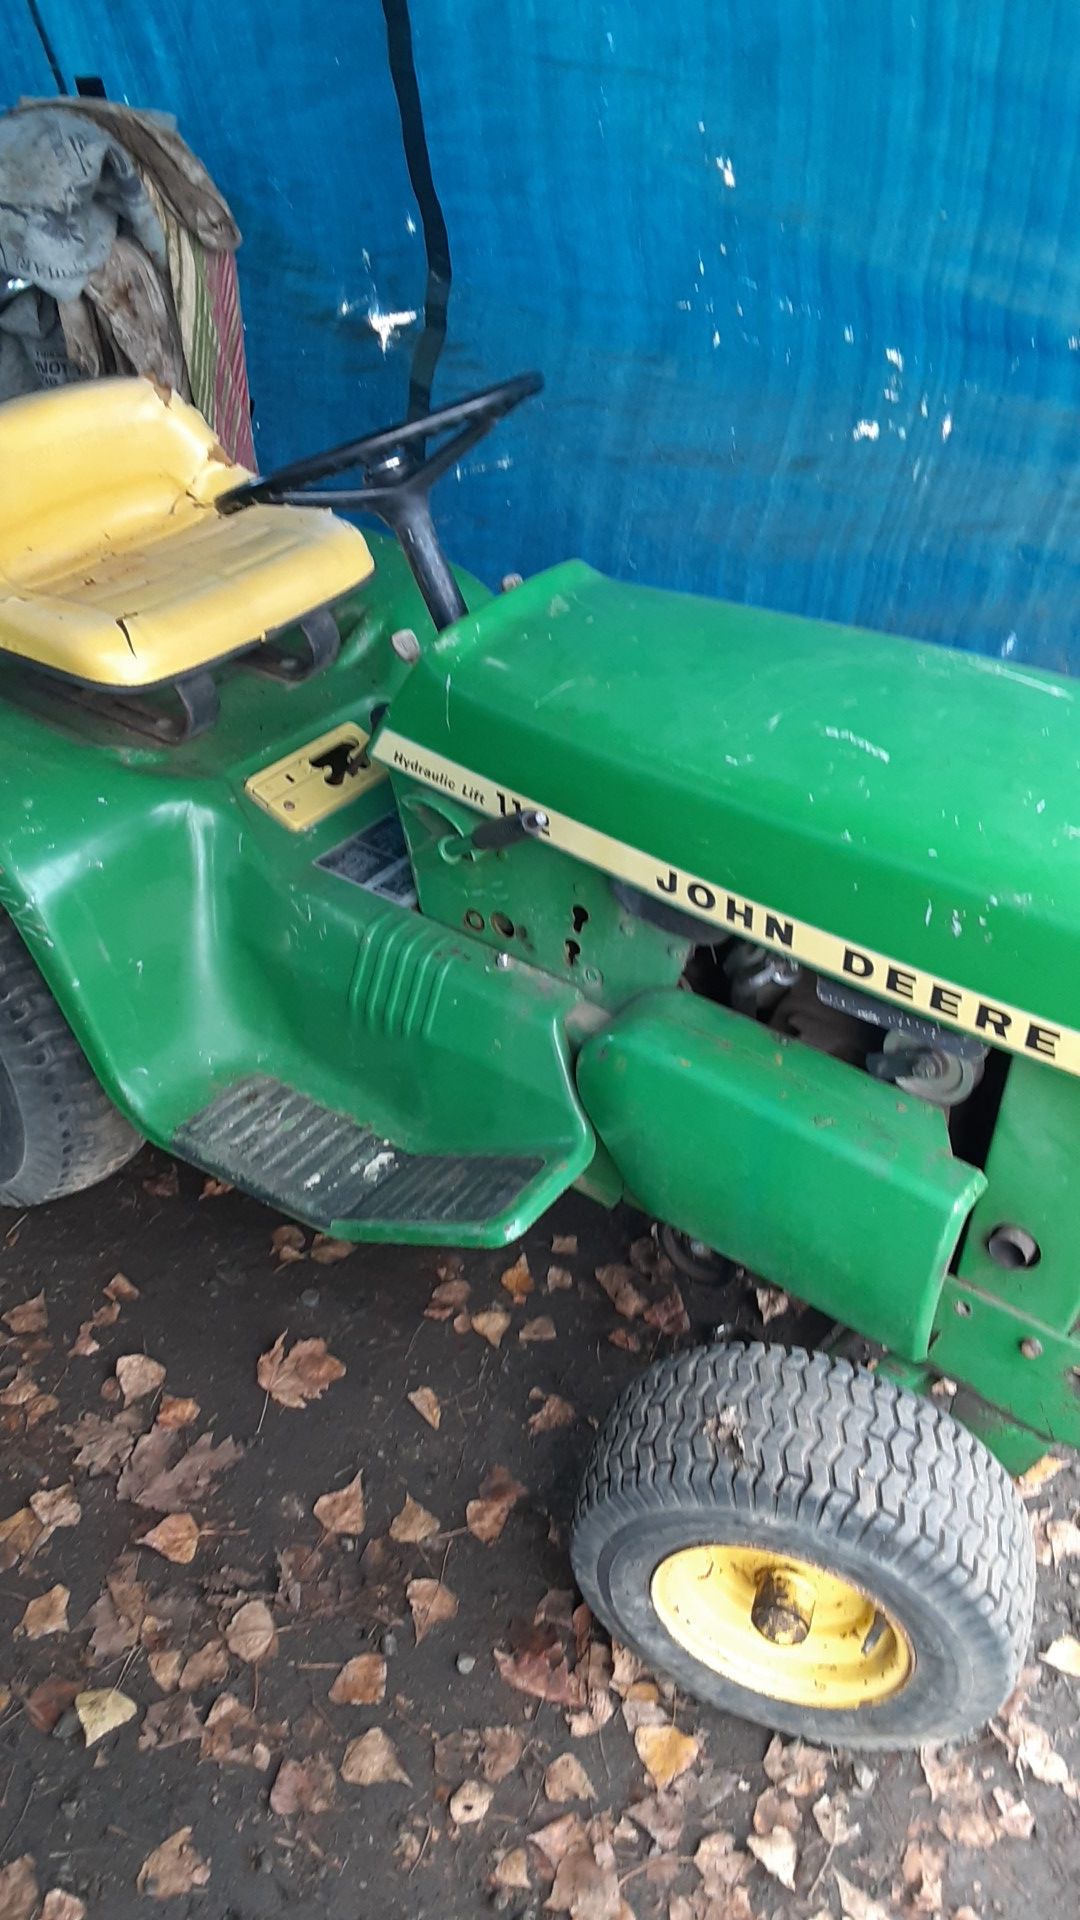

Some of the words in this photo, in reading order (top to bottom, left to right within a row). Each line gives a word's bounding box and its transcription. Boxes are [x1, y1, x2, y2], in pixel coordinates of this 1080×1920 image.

[393, 750, 456, 791] Hydraulic
[461, 783, 486, 806] Lift
[656, 870, 794, 948] JOHN
[842, 946, 1061, 1060] DEERE
